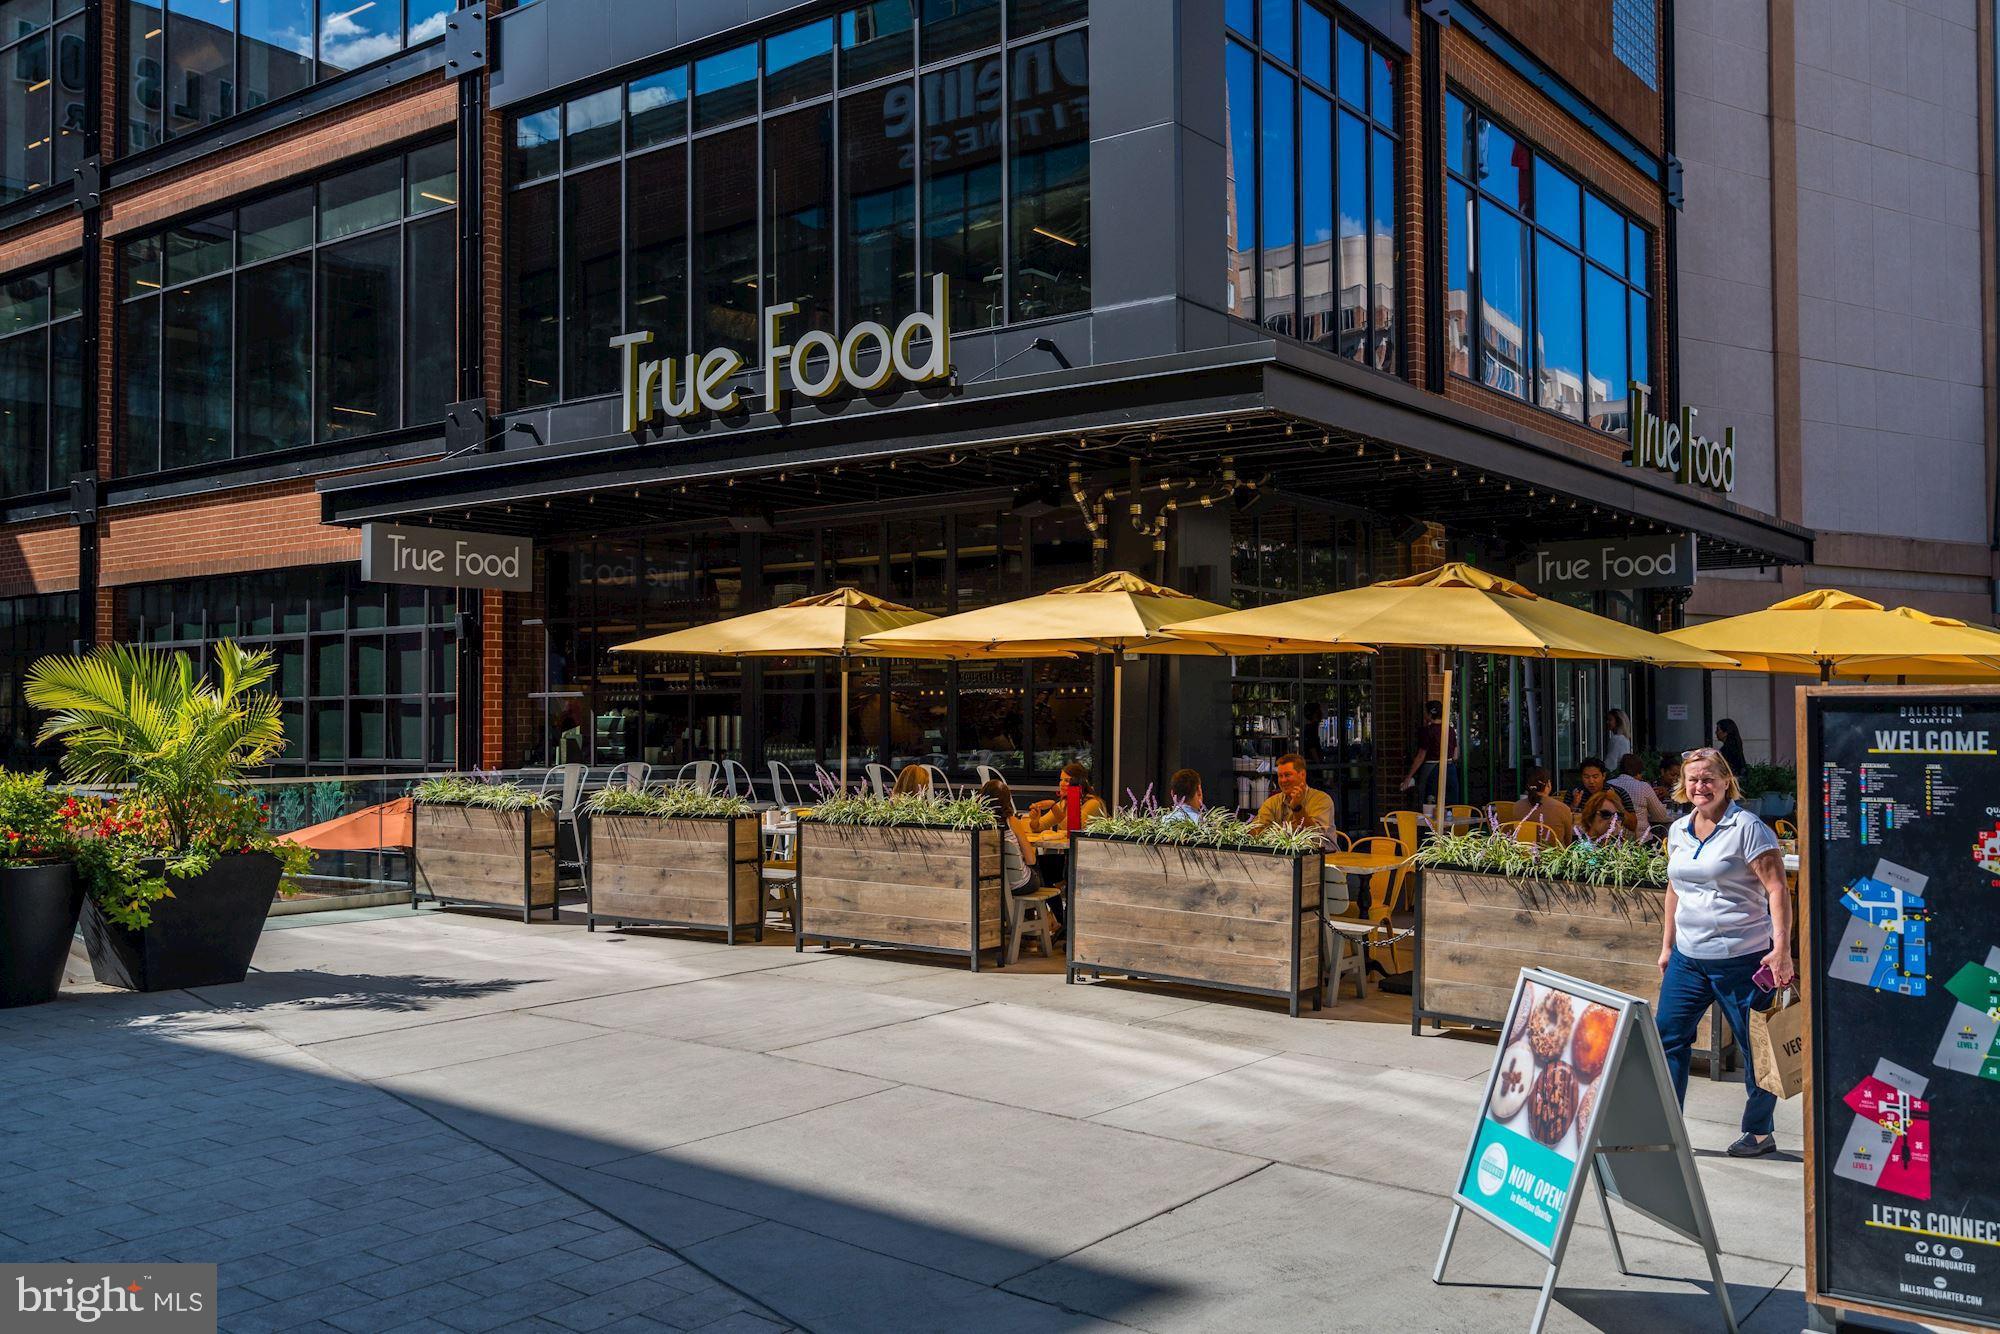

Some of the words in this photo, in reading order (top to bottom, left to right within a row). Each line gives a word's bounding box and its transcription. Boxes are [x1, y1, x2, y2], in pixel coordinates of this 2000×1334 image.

[609, 331, 744, 432] True
[765, 272, 950, 413] Food
[1629, 381, 1682, 472] True
[1682, 406, 1736, 492] Food
[388, 534, 444, 572] True
[456, 541, 519, 578] Food
[1537, 552, 1590, 584] True
[1602, 543, 1677, 581] Food
[1900, 706, 1962, 718] BALLSTON
[1875, 730, 1990, 753] WELCOME
[1985, 806, 2000, 816] QU
[1957, 1041, 1974, 1049] LEVEL
[1864, 1090, 1872, 1098] 3A
[1853, 1161, 1867, 1169] LEVEL
[1508, 1165, 1536, 1194] NOW
[1534, 1179, 1566, 1212] OPEN!
[1872, 1204, 1920, 1230] LET'S
[1905, 1253, 1976, 1273] @BALLSTONQUARTER
[1900, 1283, 1982, 1306] BALLSTONQUARTER.COM
